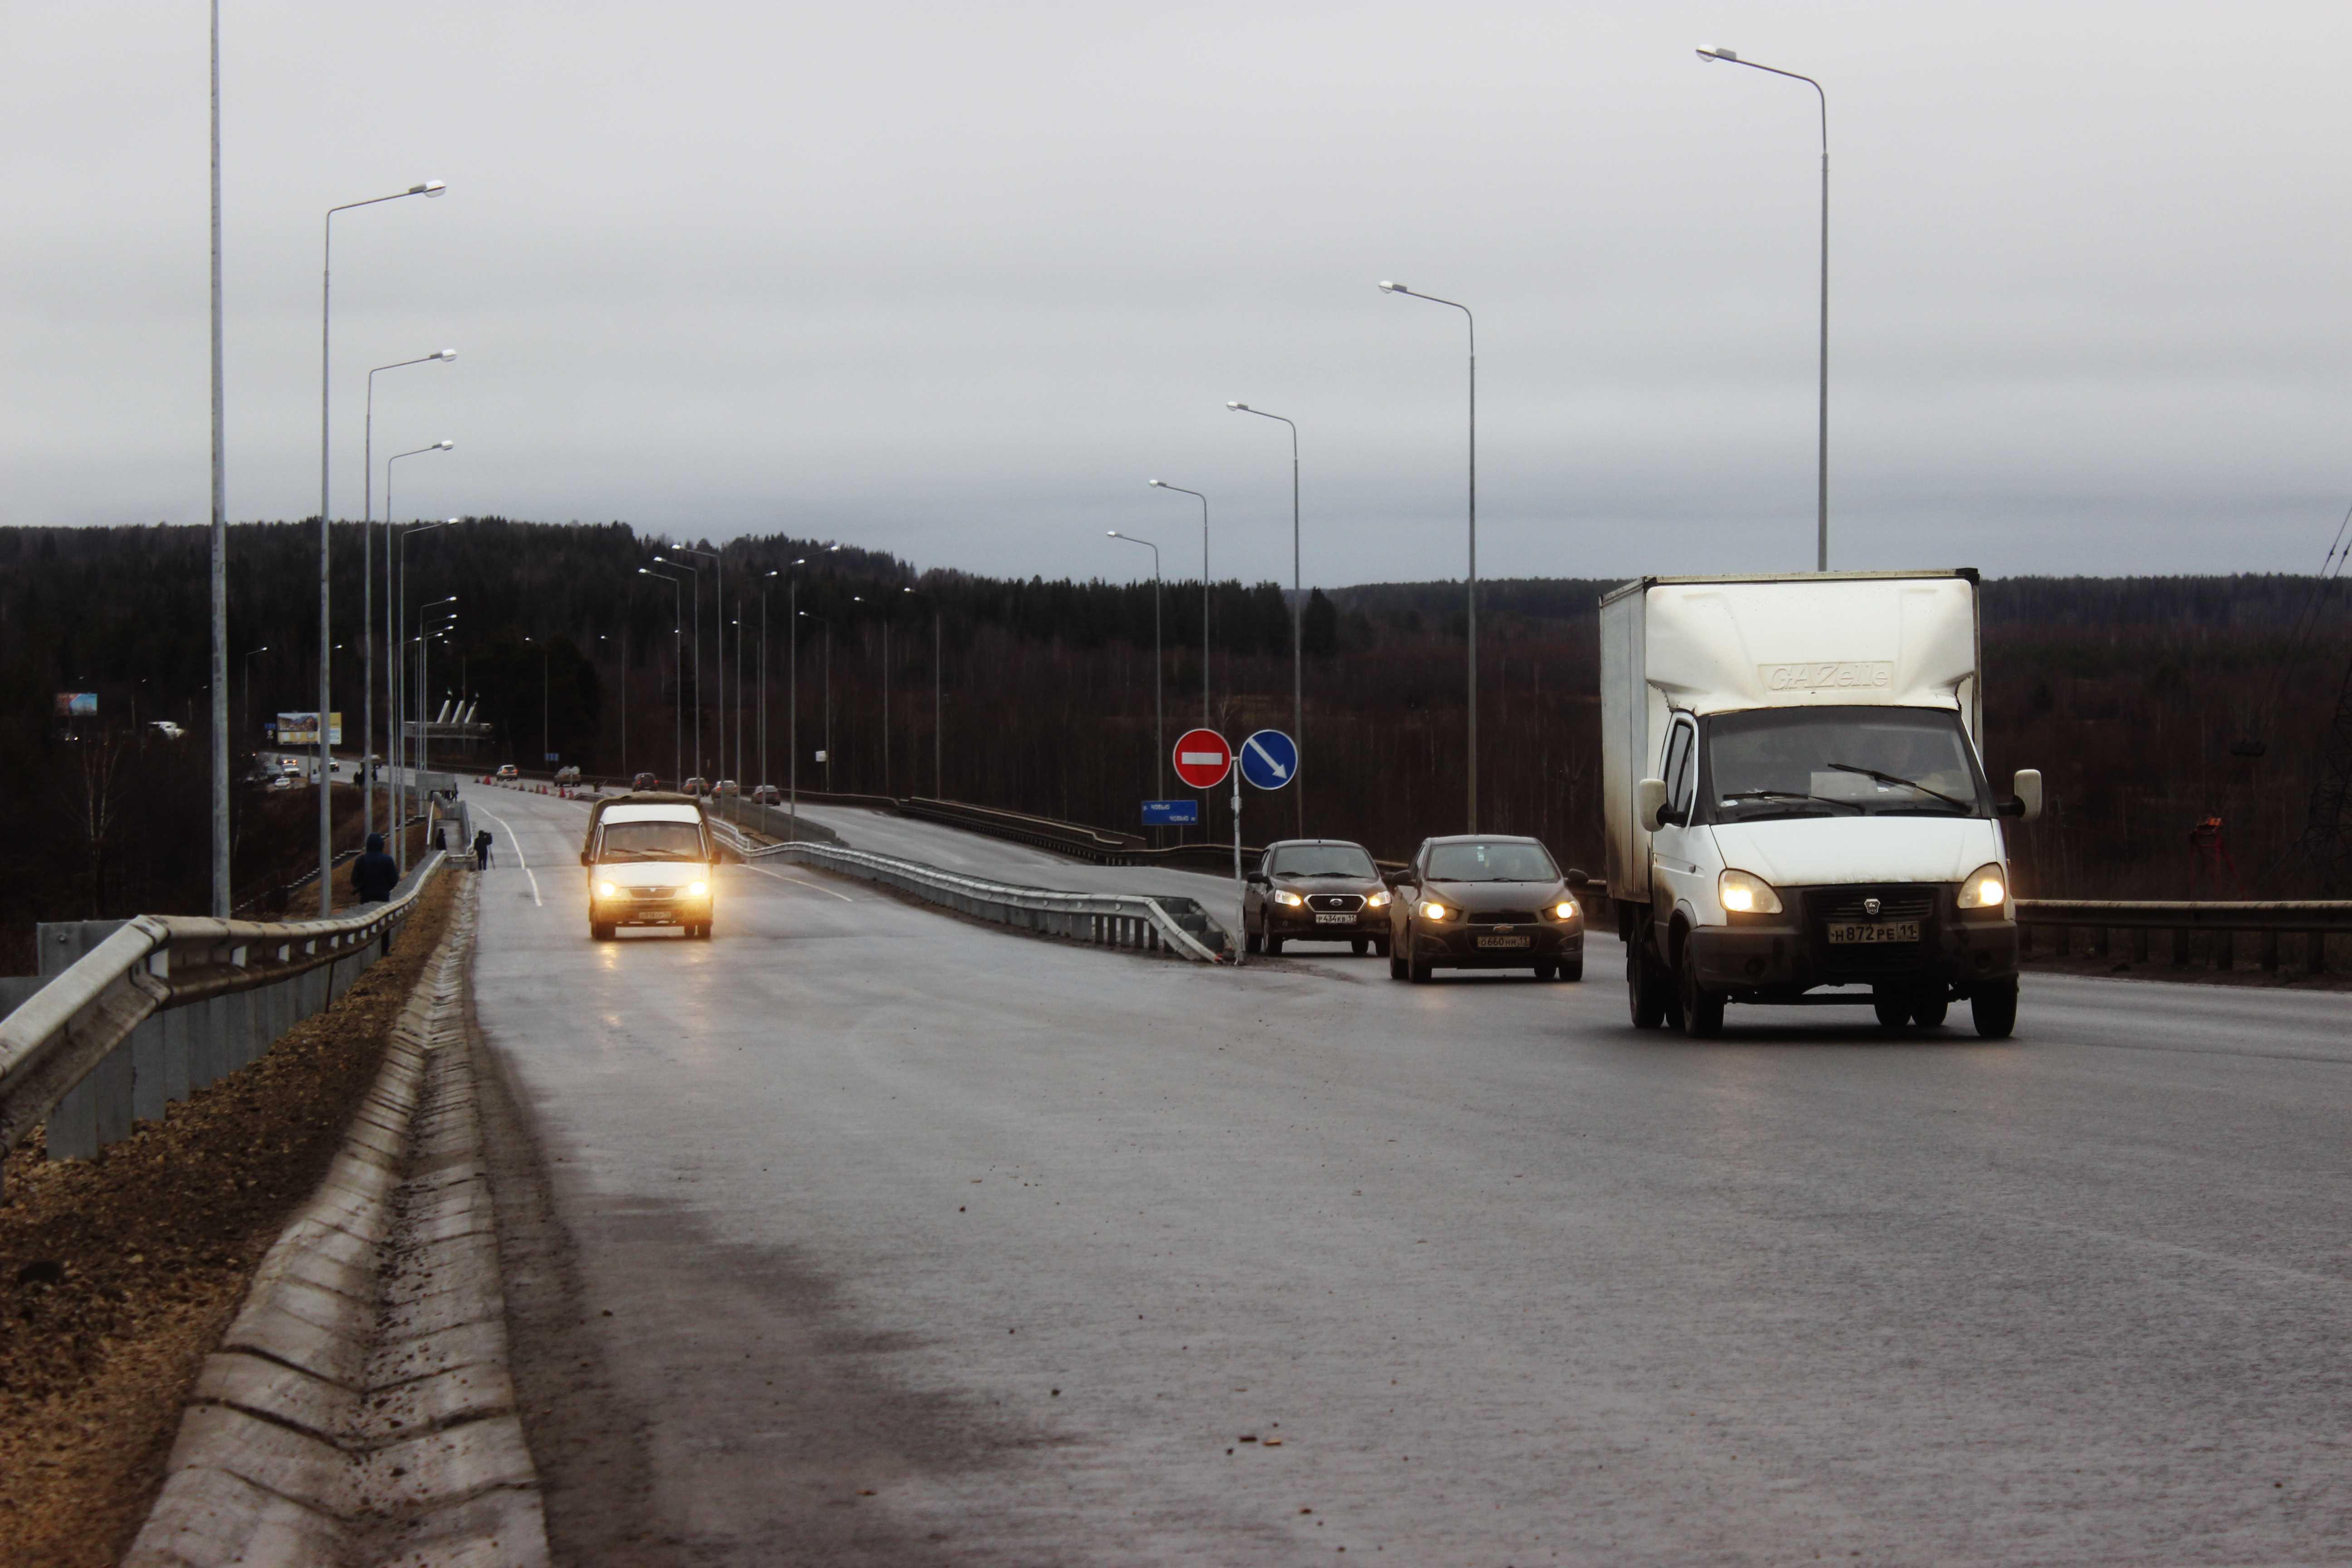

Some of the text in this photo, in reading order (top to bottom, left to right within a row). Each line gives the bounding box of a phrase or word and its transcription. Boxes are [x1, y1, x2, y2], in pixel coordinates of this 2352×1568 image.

[1769, 666, 1888, 691] GAZelle
[1519, 936, 1527, 944] 11
[1835, 924, 1913, 941] Н872РЕ 11
